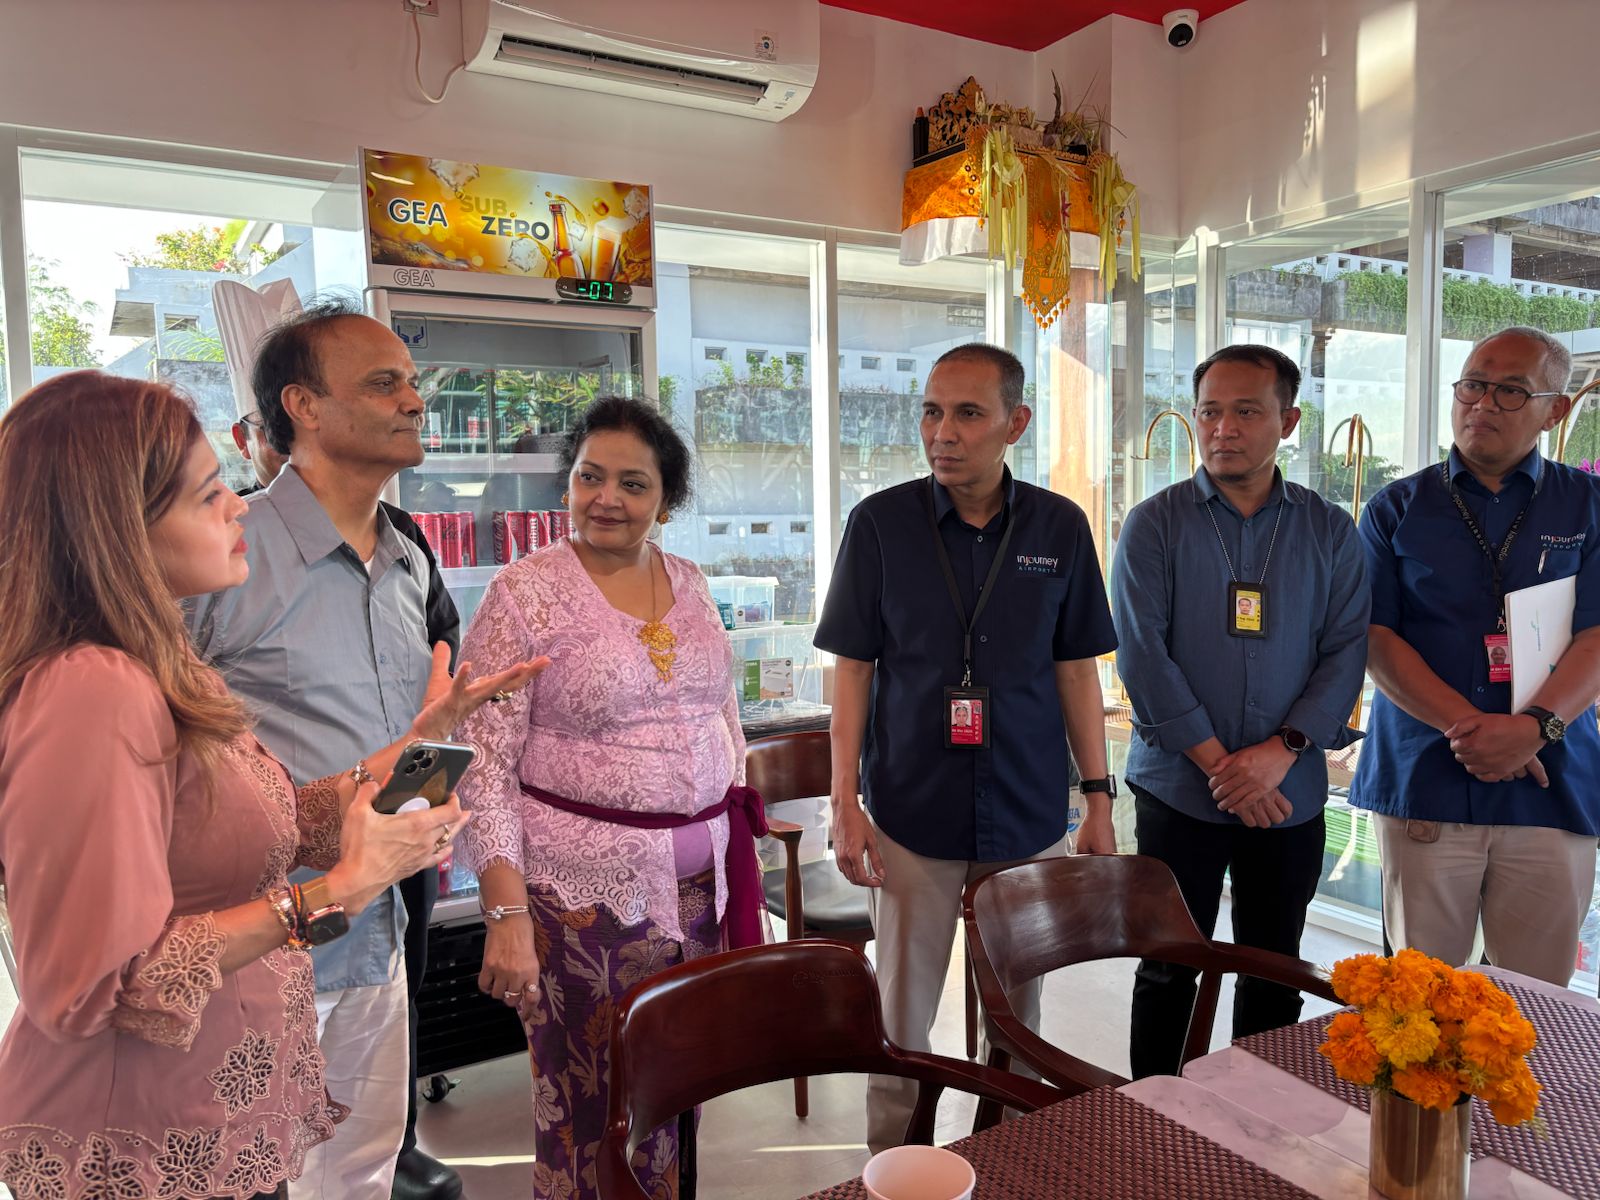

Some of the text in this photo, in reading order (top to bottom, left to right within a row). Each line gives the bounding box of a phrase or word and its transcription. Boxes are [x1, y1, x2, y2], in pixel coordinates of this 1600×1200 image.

[388, 198, 448, 227] GEA
[459, 195, 508, 217] SUB
[480, 215, 550, 241] ZERO
[393, 268, 434, 288] GEA
